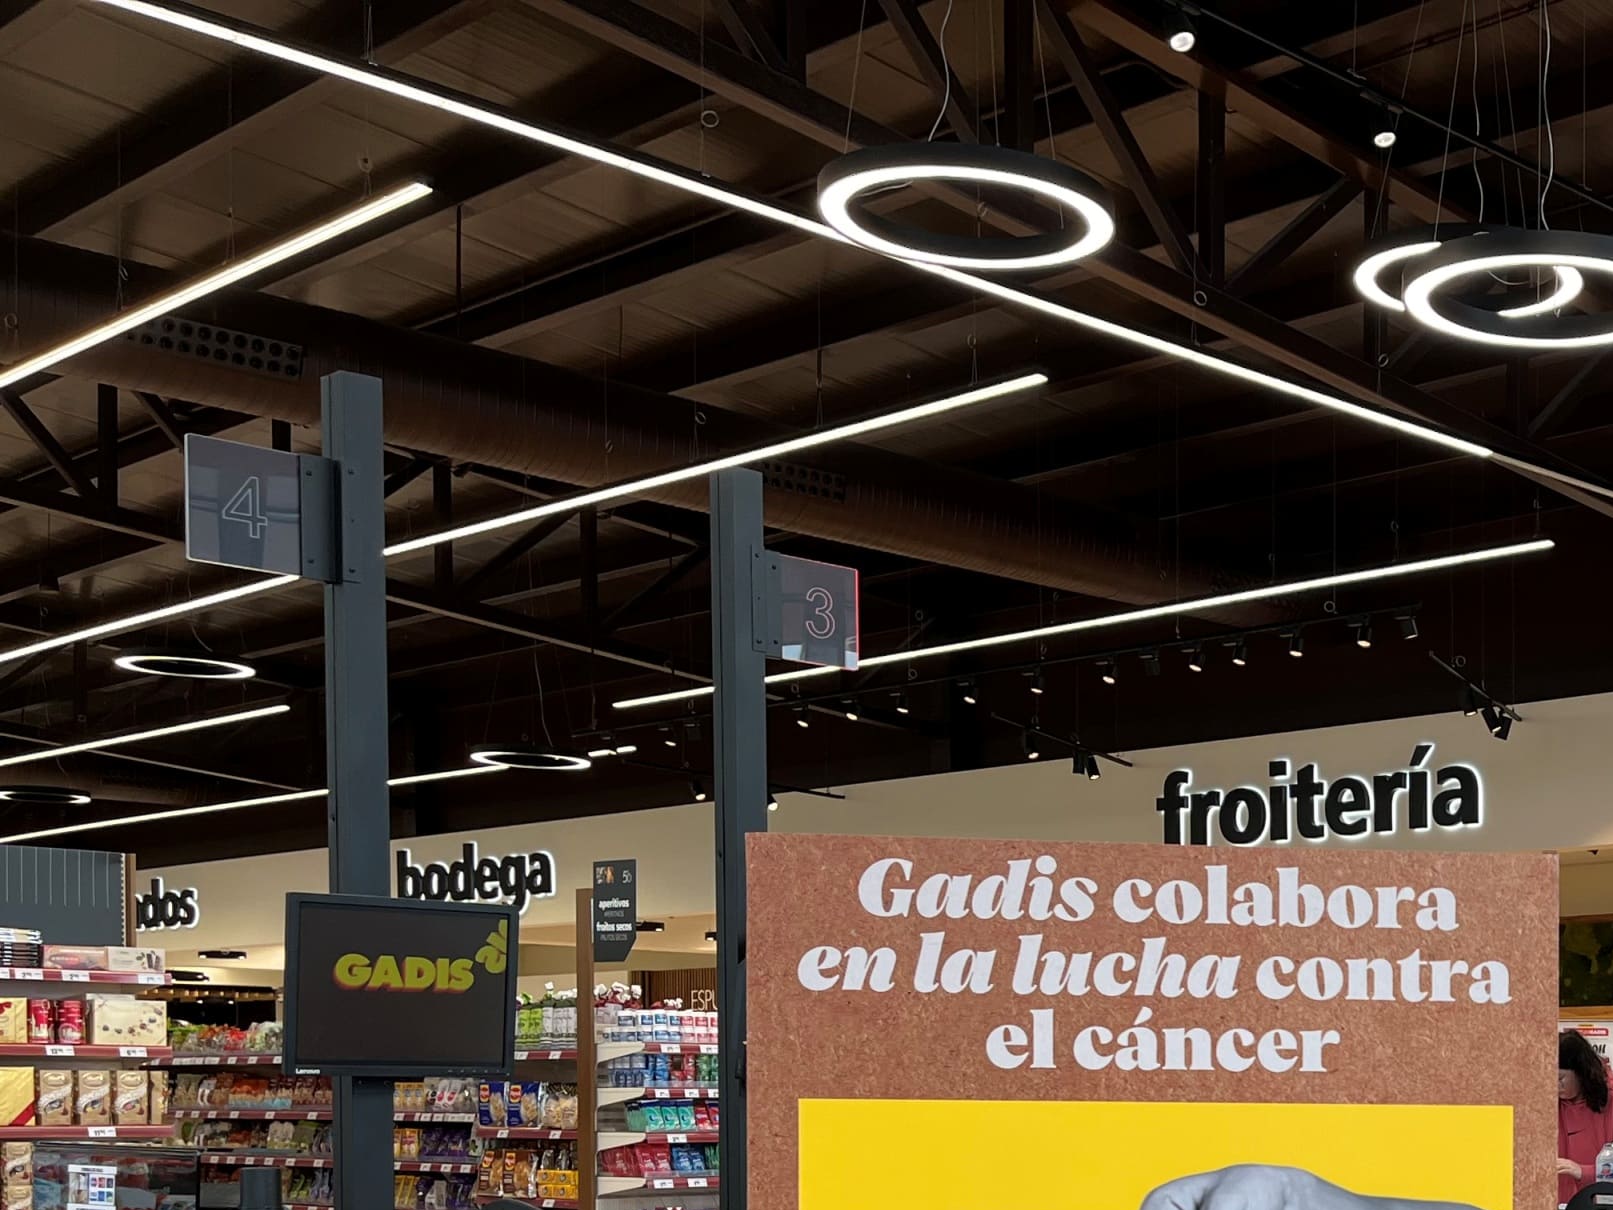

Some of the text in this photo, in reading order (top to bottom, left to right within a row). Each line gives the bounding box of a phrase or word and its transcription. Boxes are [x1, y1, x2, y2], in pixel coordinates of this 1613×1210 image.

[222, 476, 268, 539] 4
[805, 587, 836, 639] 3
[1156, 744, 1479, 847] froitería
[396, 842, 553, 909] bodega
[858, 854, 1459, 932] Gadis colabora
[332, 953, 475, 994] GADIS
[797, 931, 1512, 1005] en la lucha contra
[985, 1006, 1341, 1073] el cáncer
